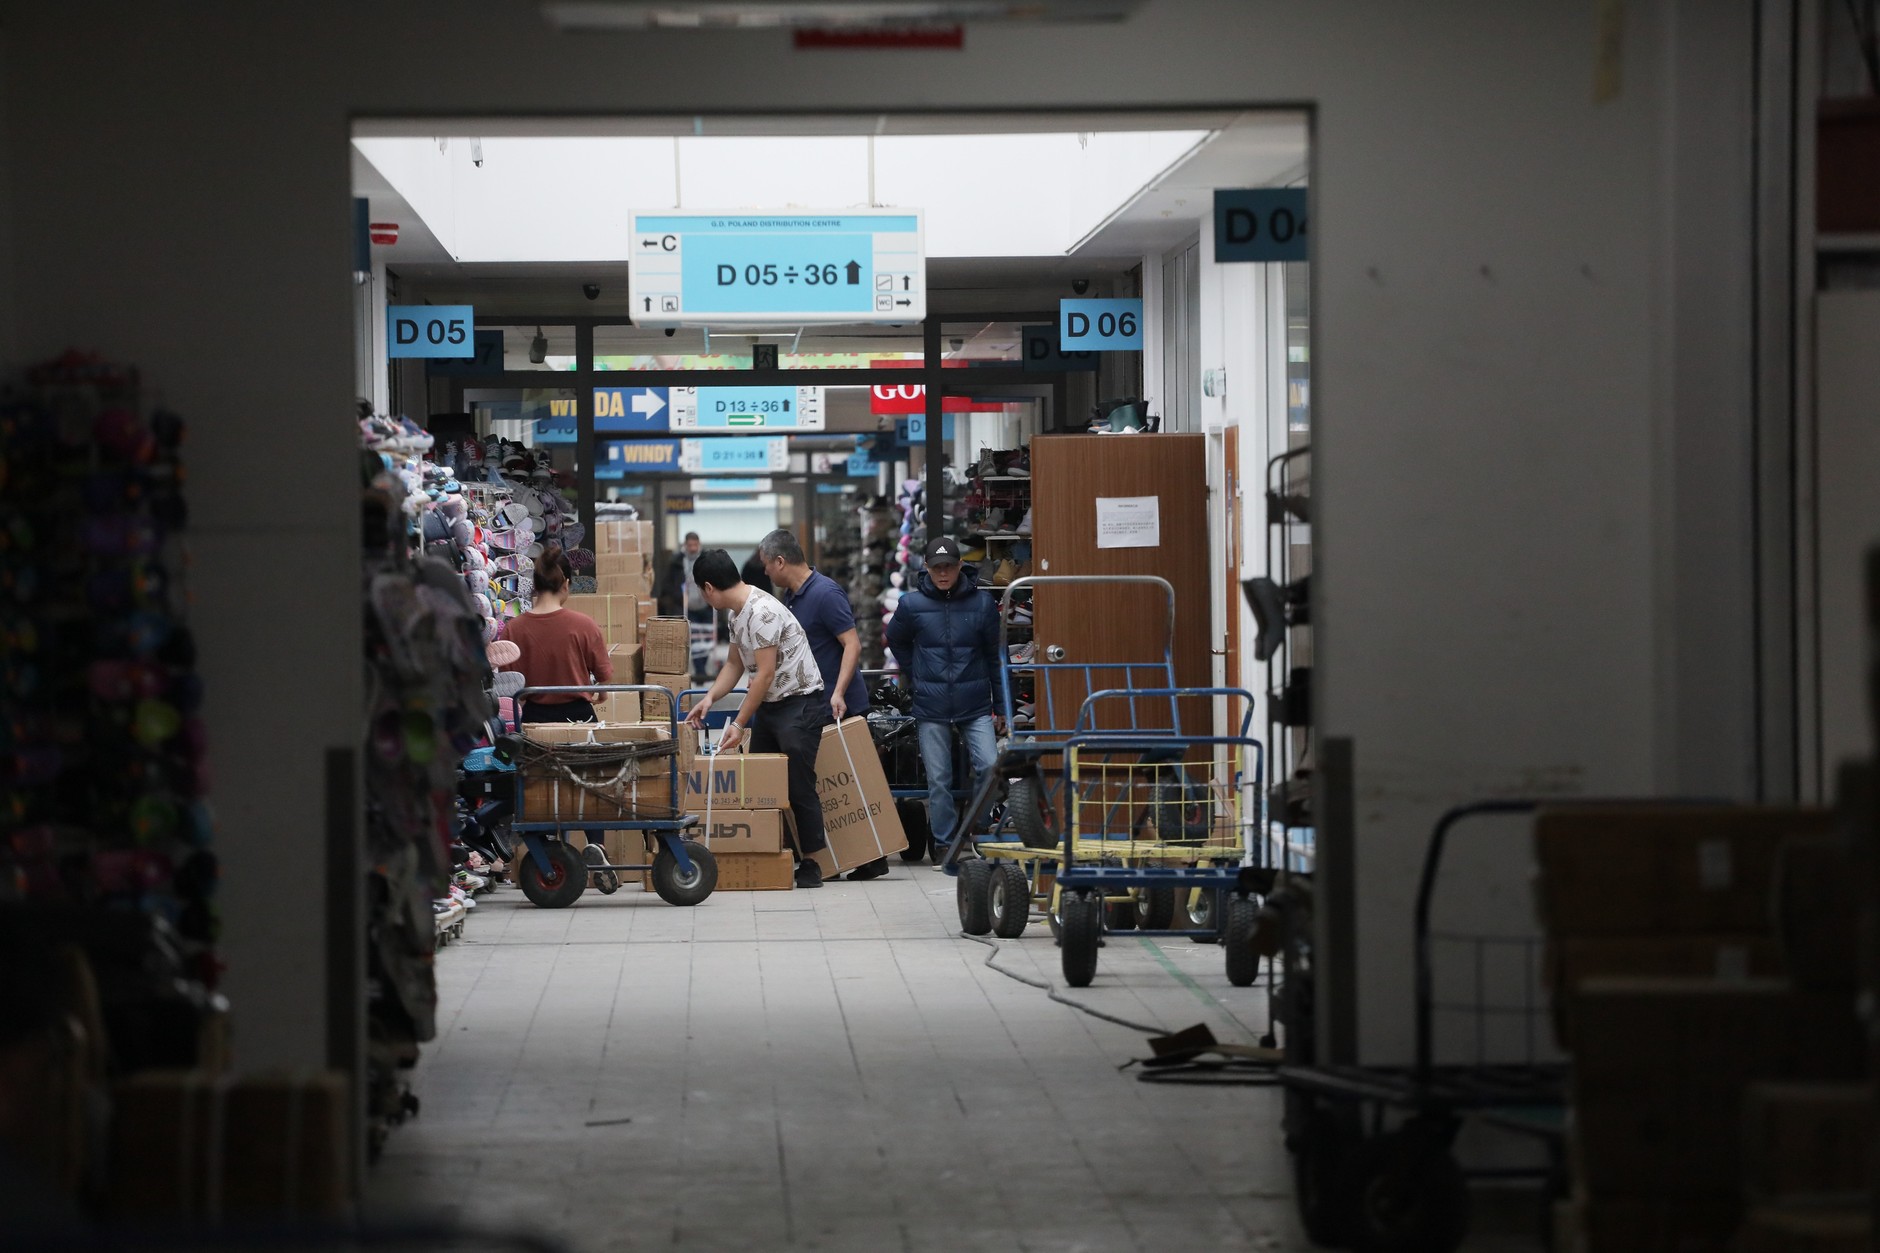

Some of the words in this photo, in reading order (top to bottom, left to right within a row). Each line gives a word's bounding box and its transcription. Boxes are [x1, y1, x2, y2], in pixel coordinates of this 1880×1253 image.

[1226, 208, 1258, 244] D
[1270, 207, 1307, 244] 0
[661, 235, 677, 252] C
[717, 264, 737, 286] D
[396, 319, 419, 345] D
[426, 319, 466, 345] 05
[1067, 312, 1090, 338] D
[1098, 311, 1136, 337] 06
[873, 384, 926, 400] GO
[551, 391, 625, 417] WIDA
[715, 401, 727, 413] D
[623, 444, 674, 464] WINDY
